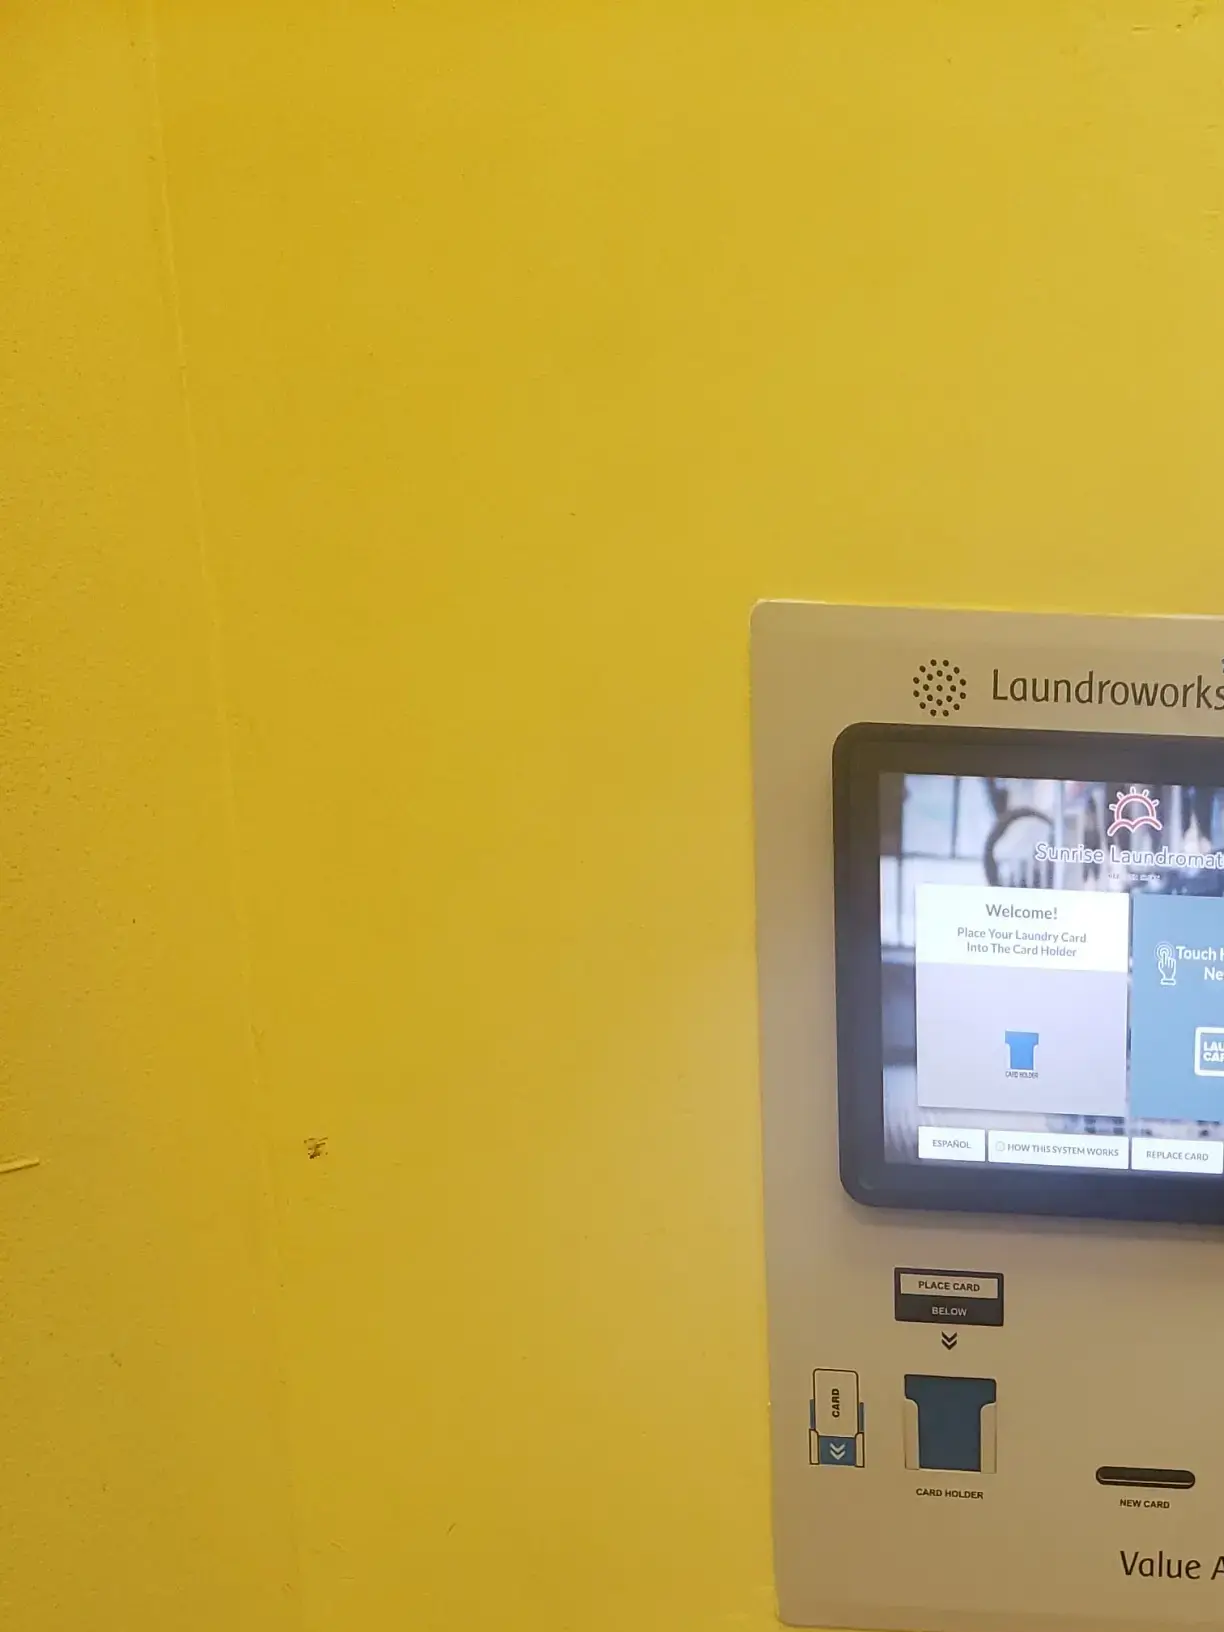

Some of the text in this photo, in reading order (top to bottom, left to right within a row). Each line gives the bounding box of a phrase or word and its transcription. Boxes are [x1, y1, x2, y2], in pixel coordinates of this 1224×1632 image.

[1035, 842, 1104, 864] Sunrise
[985, 903, 1058, 920] Welcome!
[957, 927, 1087, 943] Place Your Laundry Card
[967, 942, 1077, 957] Into The Card Holder
[1175, 945, 1217, 961] Touch
[931, 1138, 972, 1150] ESPAÑOL
[1007, 1143, 1119, 1157] HOW THIS SYSTEM WORKS
[1146, 1149, 1209, 1161] REPLACE CARD
[918, 1280, 980, 1293] PLACE CARD
[931, 1305, 967, 1317] BELOW
[831, 1388, 841, 1418] CARD
[916, 1488, 984, 1500] CARD HOLDER
[1120, 1499, 1170, 1509] NEW CARD
[1120, 1550, 1201, 1579] Value
